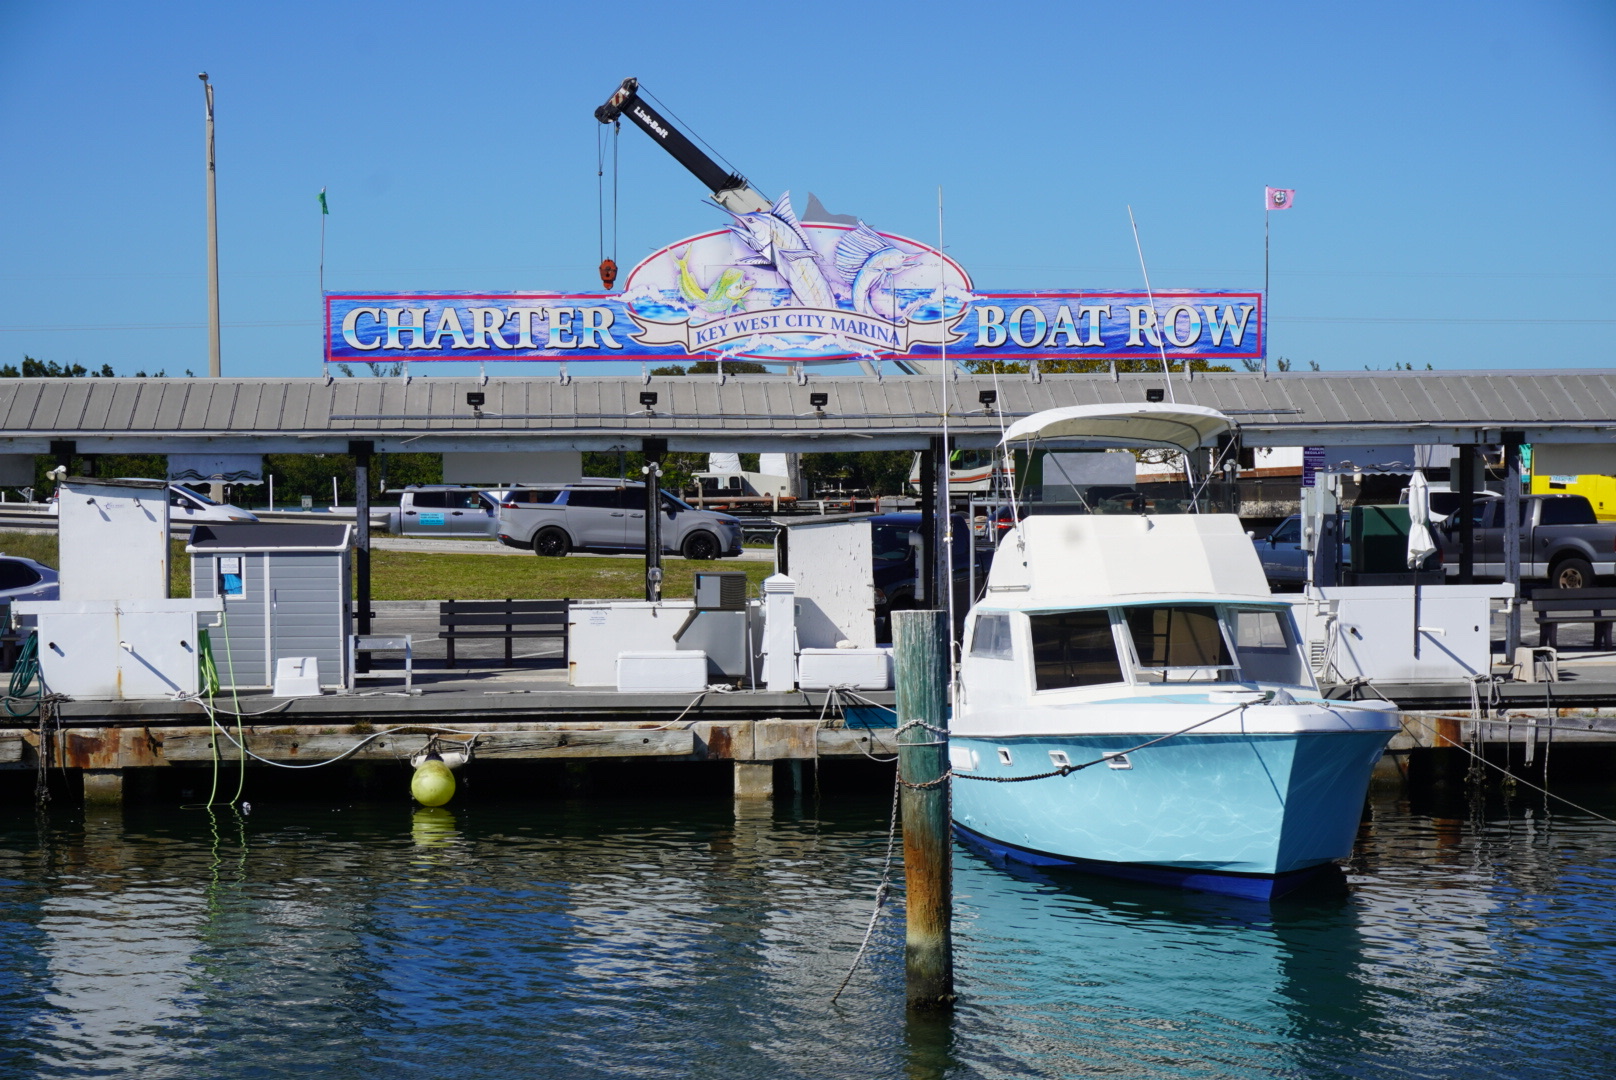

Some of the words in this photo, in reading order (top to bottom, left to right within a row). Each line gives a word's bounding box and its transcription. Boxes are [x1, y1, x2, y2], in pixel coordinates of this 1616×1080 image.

[633, 105, 669, 139] Link-Belt
[341, 306, 624, 350] CHARTER
[695, 323, 729, 345] KEY
[733, 315, 781, 333] WEST
[785, 314, 826, 328] CITY
[830, 316, 901, 346] MARINA
[974, 304, 1112, 348] BOAT
[1125, 304, 1255, 348] ROW
